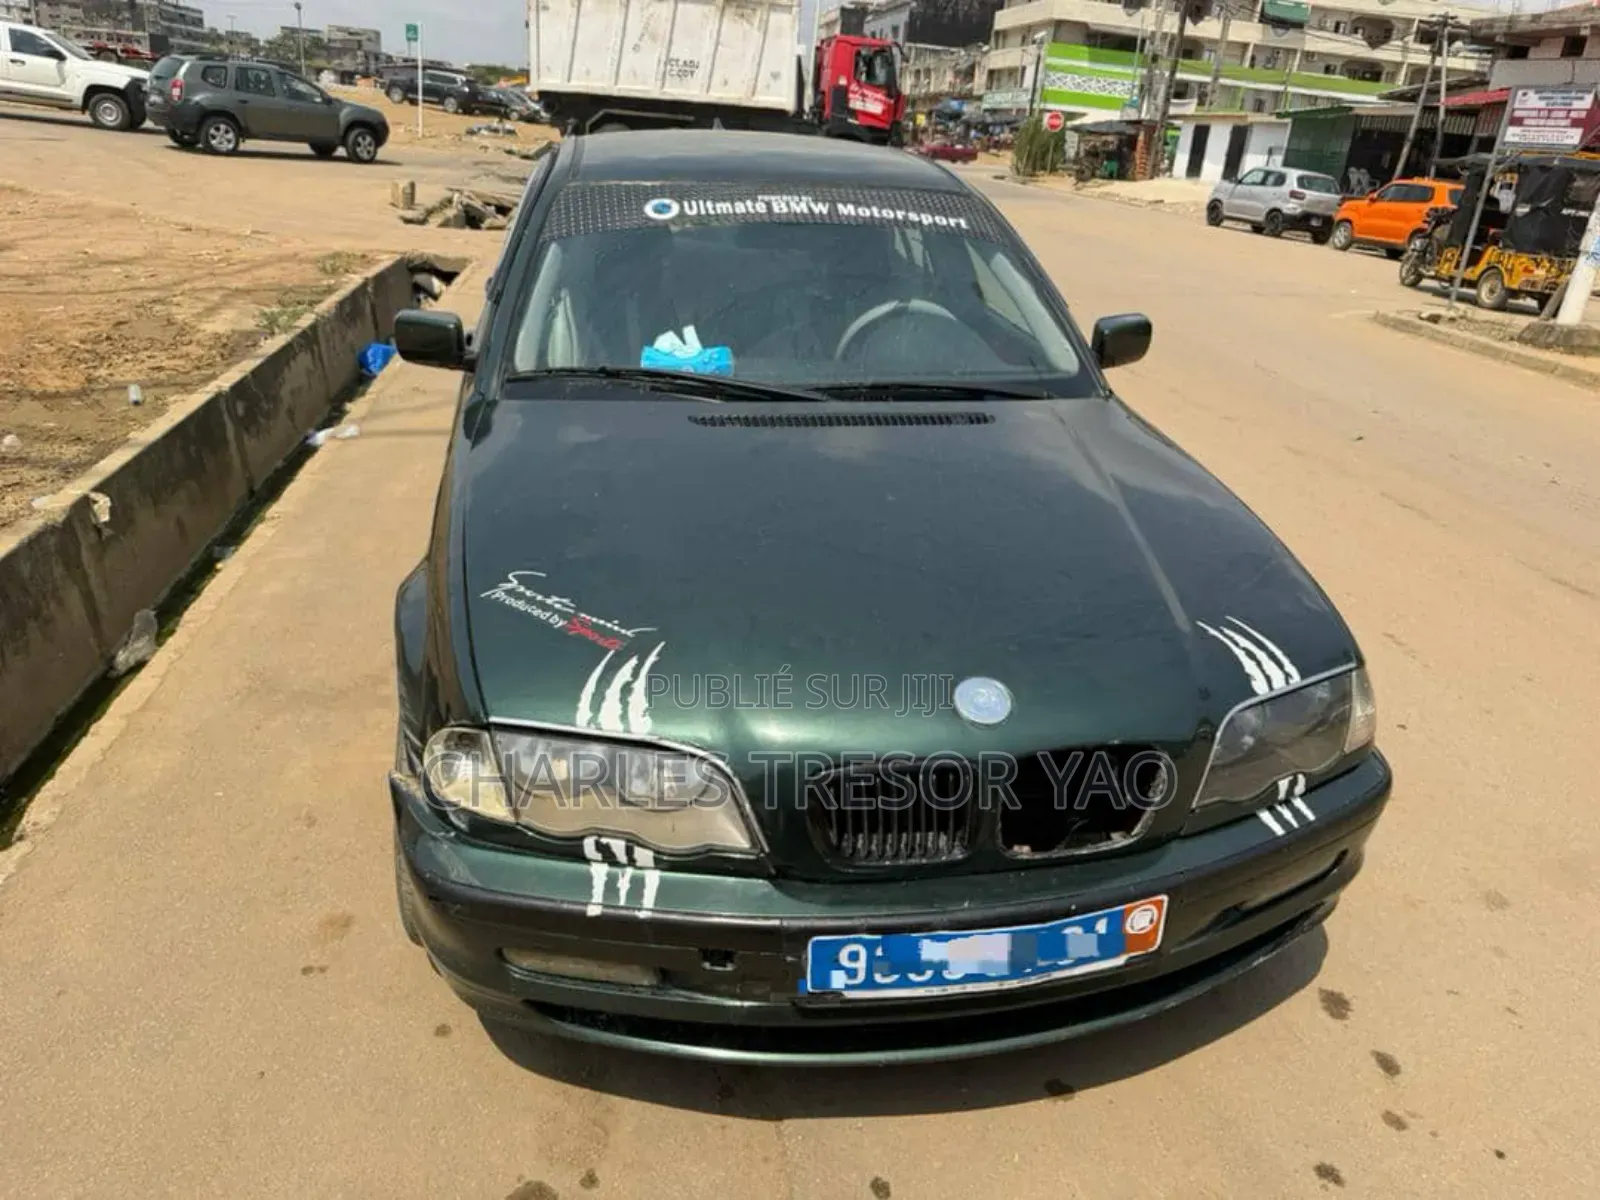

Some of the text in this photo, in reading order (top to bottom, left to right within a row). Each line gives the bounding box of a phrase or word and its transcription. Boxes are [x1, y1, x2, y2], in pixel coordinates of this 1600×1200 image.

[683, 199, 970, 230] Ultmate BMW Motorsport
[490, 589, 555, 622] Produced
[549, 614, 569, 629] by
